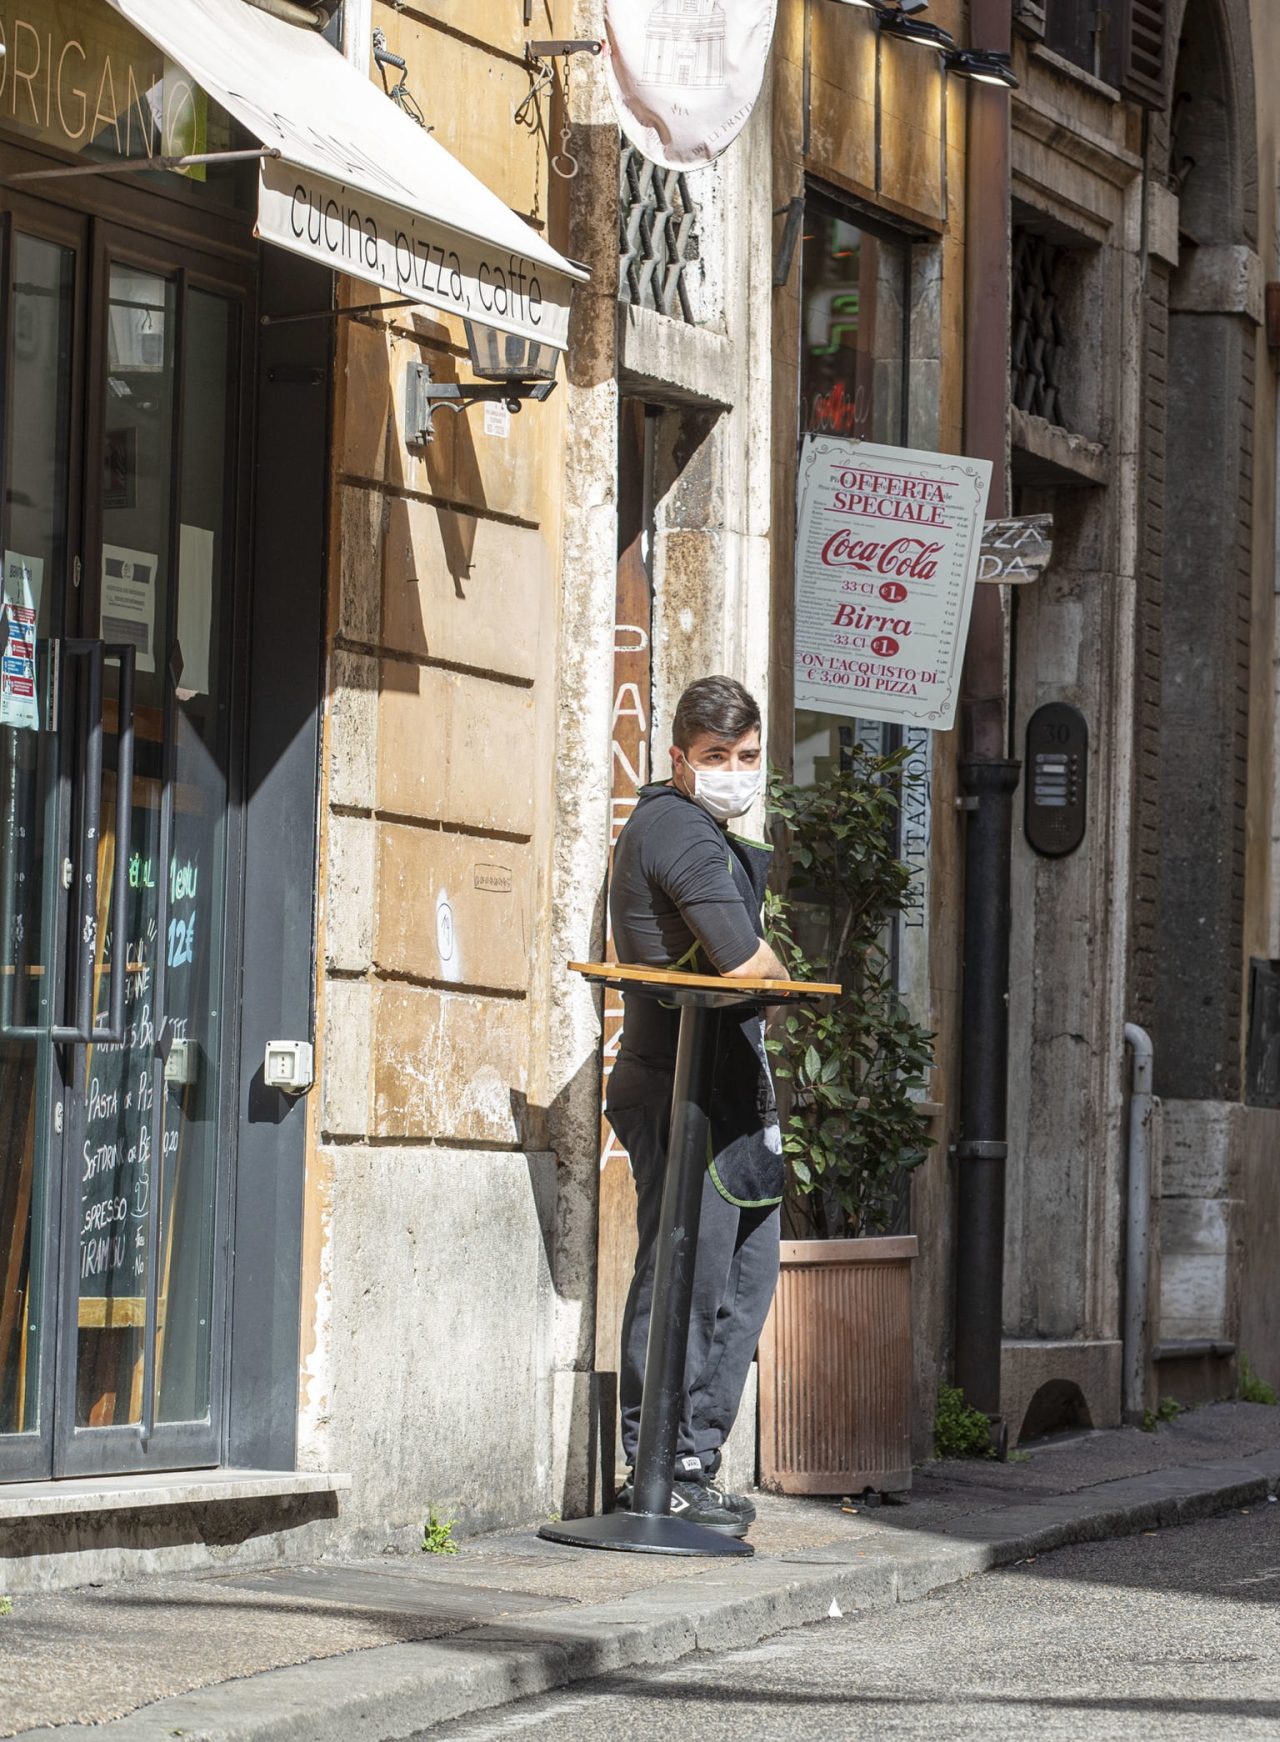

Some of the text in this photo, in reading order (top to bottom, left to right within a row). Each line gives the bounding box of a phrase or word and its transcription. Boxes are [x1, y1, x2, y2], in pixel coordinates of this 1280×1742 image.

[0, 19, 196, 173] RIGANO
[289, 184, 543, 326] cucina, pizza, caffè
[839, 470, 946, 503] OFFERTA
[833, 491, 946, 525] SPECIALE
[820, 528, 946, 580] Coca-Cola
[841, 580, 858, 592] 33
[831, 602, 913, 637] Birra
[833, 634, 849, 646] 33
[807, 669, 918, 695] € 3,00 DI PIZZA
[829, 658, 916, 681] L'ACQUISTO
[920, 671, 938, 685] DI
